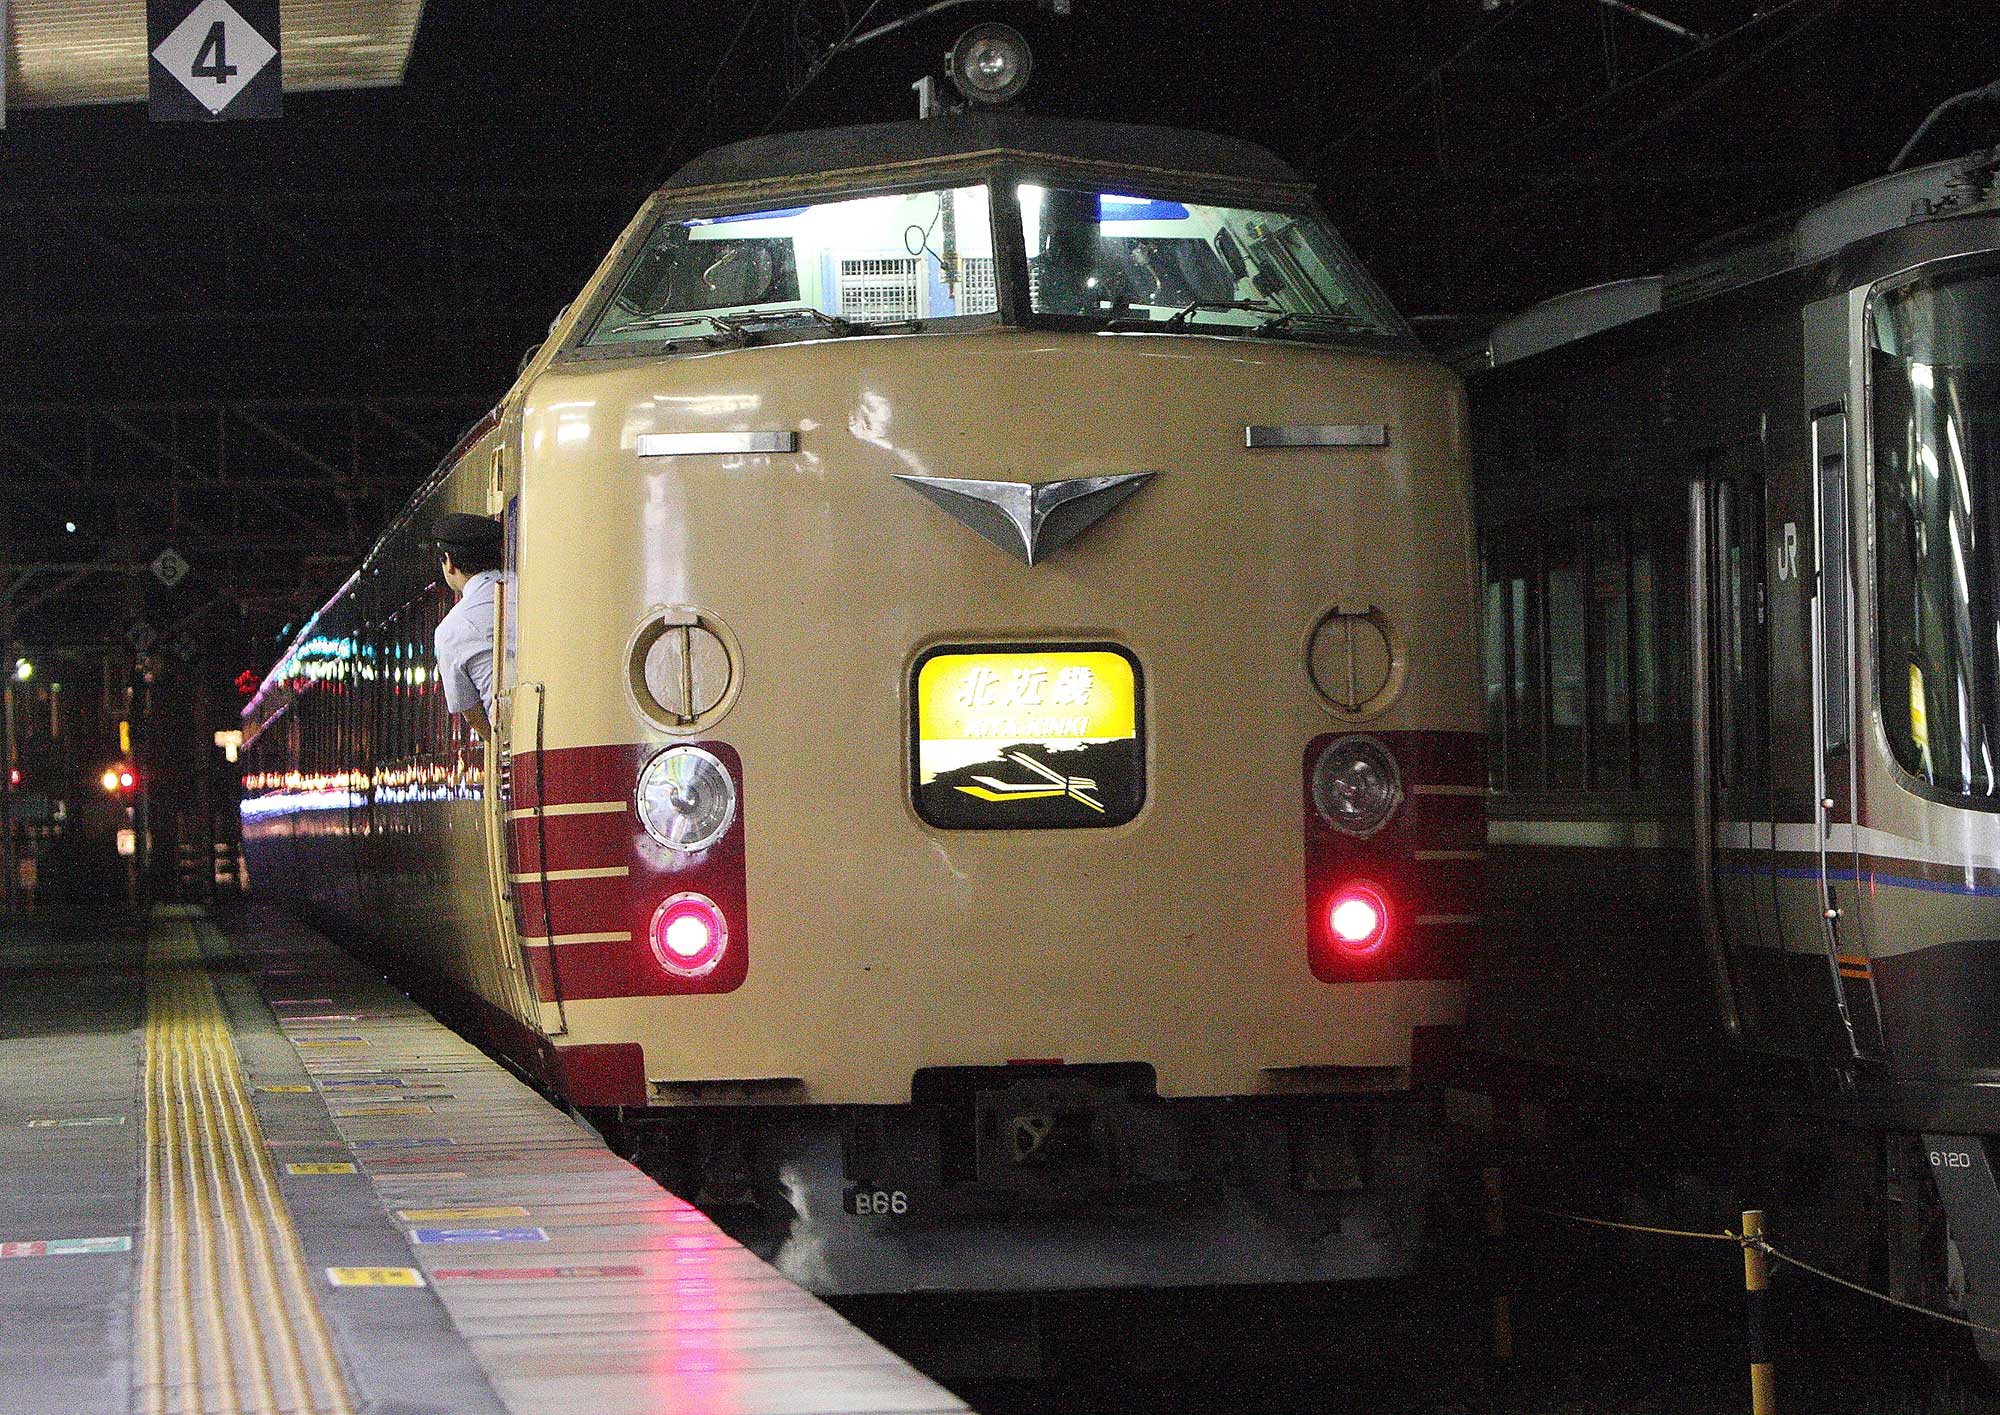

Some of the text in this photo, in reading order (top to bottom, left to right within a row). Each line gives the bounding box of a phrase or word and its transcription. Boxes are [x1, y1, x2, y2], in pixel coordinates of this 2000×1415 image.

[191, 21, 238, 84] 4
[1778, 522, 1798, 580] JR
[1930, 1151, 1970, 1168] 6120
[855, 1190, 908, 1215] B66
